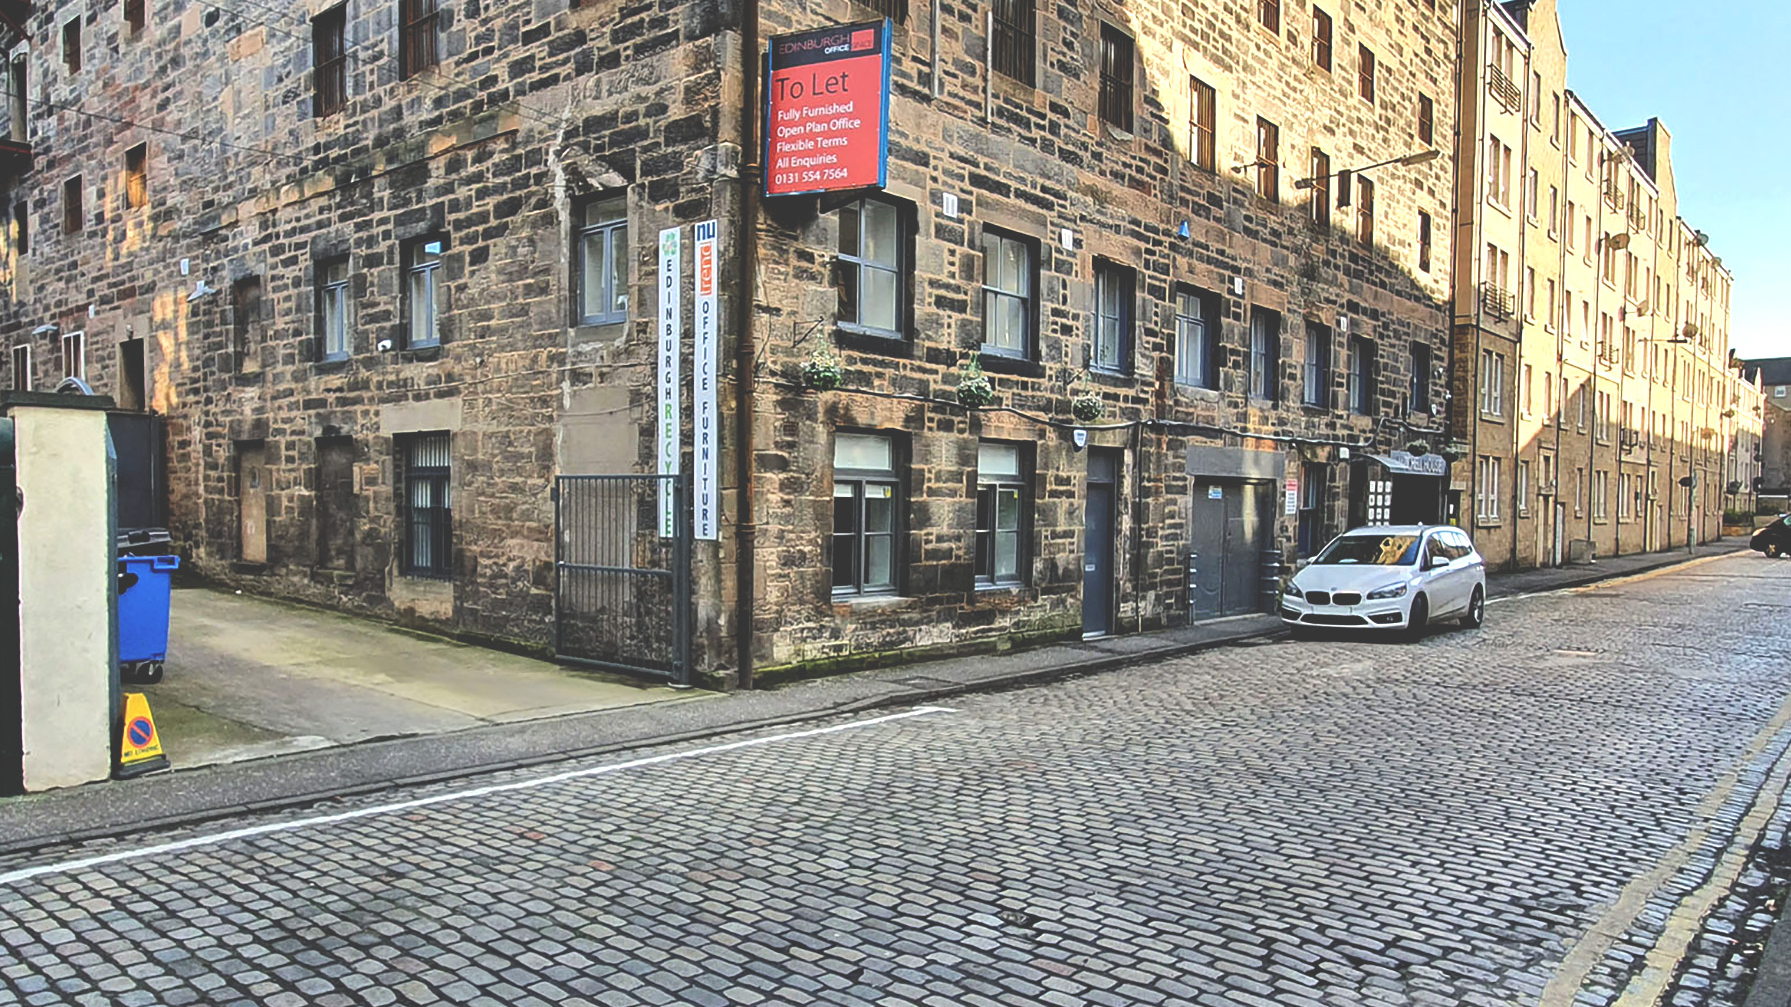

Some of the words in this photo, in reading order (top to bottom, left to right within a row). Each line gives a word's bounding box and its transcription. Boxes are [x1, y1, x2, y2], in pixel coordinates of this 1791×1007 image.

[779, 34, 850, 54] EDINBURGH
[824, 44, 850, 54] OFFICE
[775, 77, 804, 101] To
[812, 72, 849, 96] Let
[778, 108, 801, 122] Fully
[802, 100, 853, 118] Furnished
[777, 126, 804, 138] Open
[806, 121, 828, 133] Plan
[829, 117, 861, 131] Office
[776, 139, 815, 153] Flexible
[816, 136, 848, 148] Terms
[776, 157, 790, 169] All
[791, 153, 838, 168] Enquiries
[775, 172, 799, 185] 0131
[801, 170, 821, 182] 554
[822, 167, 848, 180] 7564
